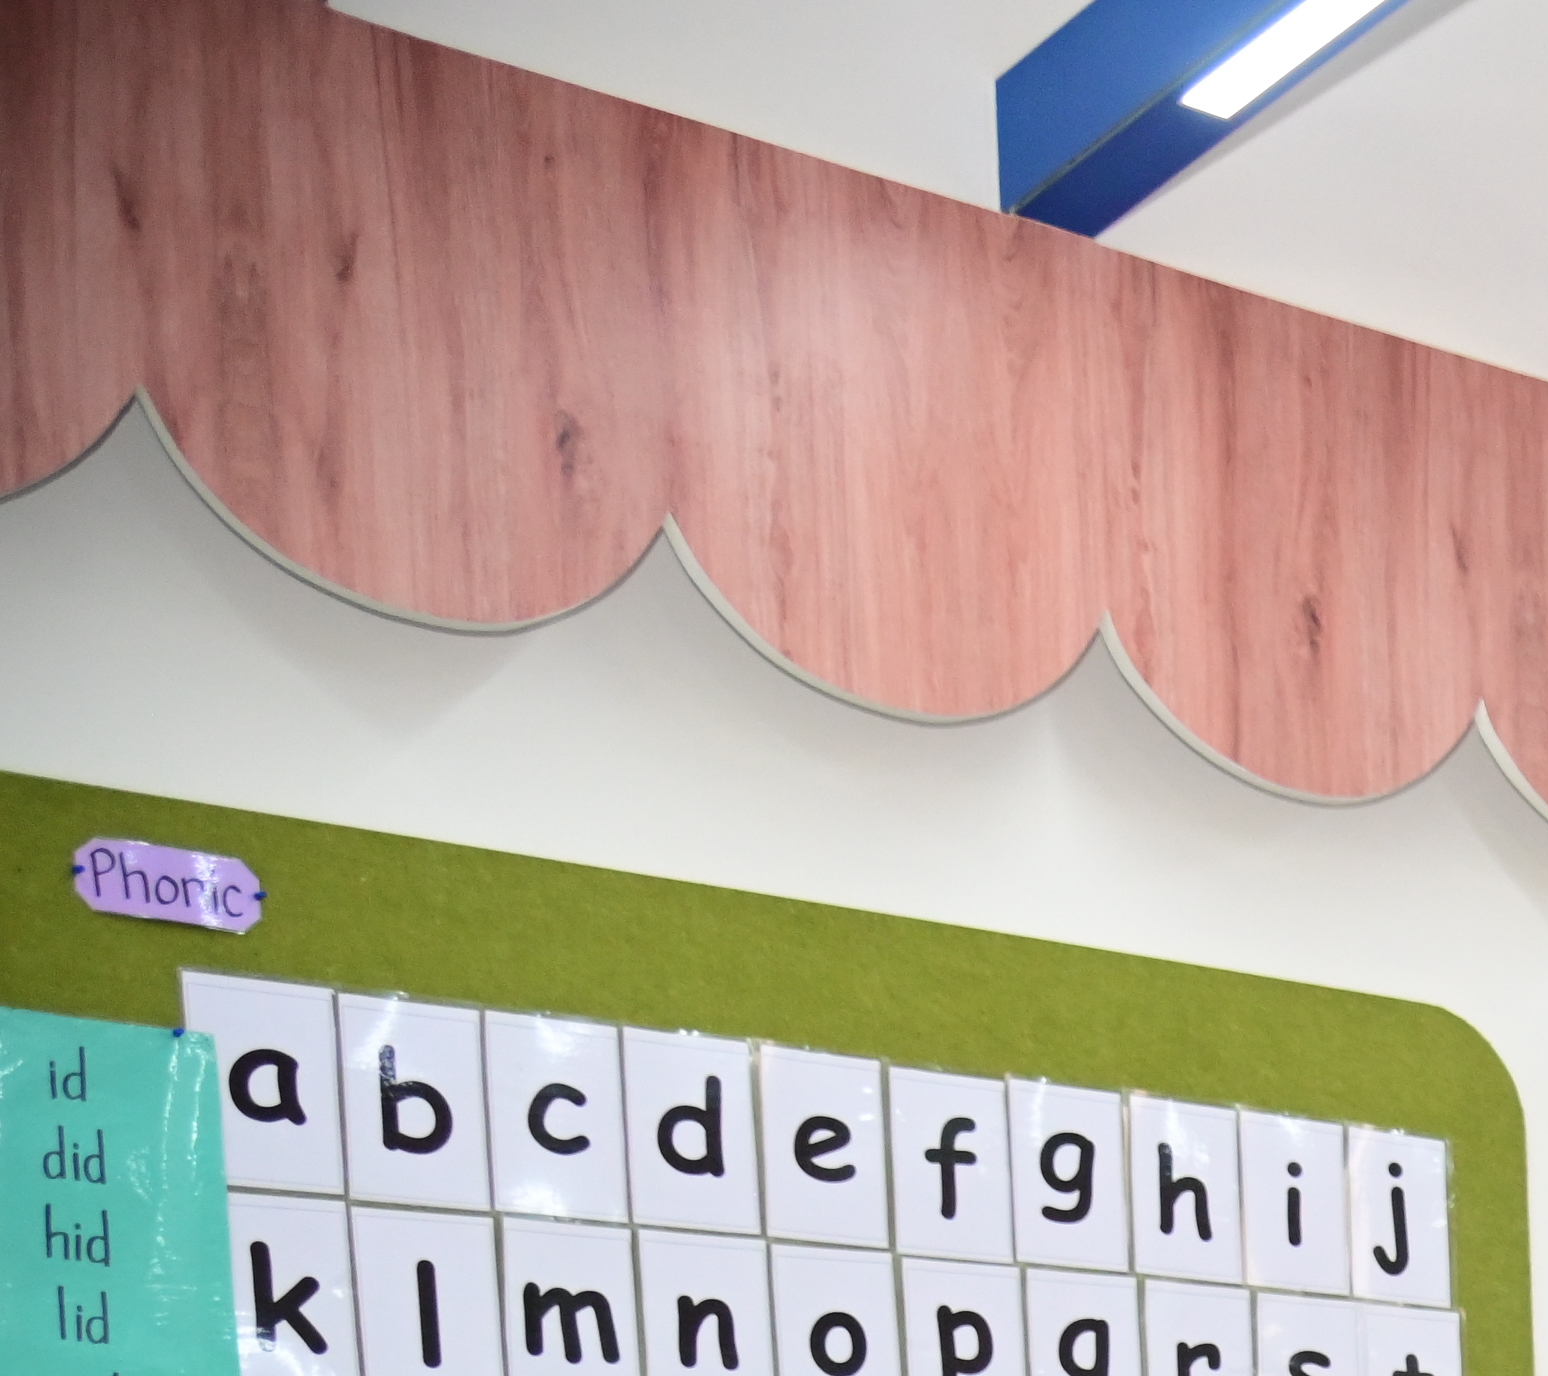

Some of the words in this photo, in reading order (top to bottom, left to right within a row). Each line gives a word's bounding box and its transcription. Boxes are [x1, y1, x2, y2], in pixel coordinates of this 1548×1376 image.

[88, 847, 245, 919] Phonic
[48, 1047, 88, 1103] id
[42, 1126, 107, 1186] did
[228, 1048, 307, 1126] a
[379, 1044, 453, 1155] b
[527, 1082, 591, 1156] c
[656, 1075, 725, 1178] d
[793, 1115, 856, 1183] e
[924, 1116, 977, 1220] f
[1039, 1132, 1095, 1224] g
[1157, 1142, 1213, 1242] h
[1287, 1161, 1302, 1247] i
[1372, 1162, 1409, 1276] j
[44, 1203, 111, 1268] hid
[58, 1286, 111, 1344] lid
[249, 1240, 328, 1355] k
[522, 1281, 620, 1365] m
[676, 1295, 739, 1371] n
